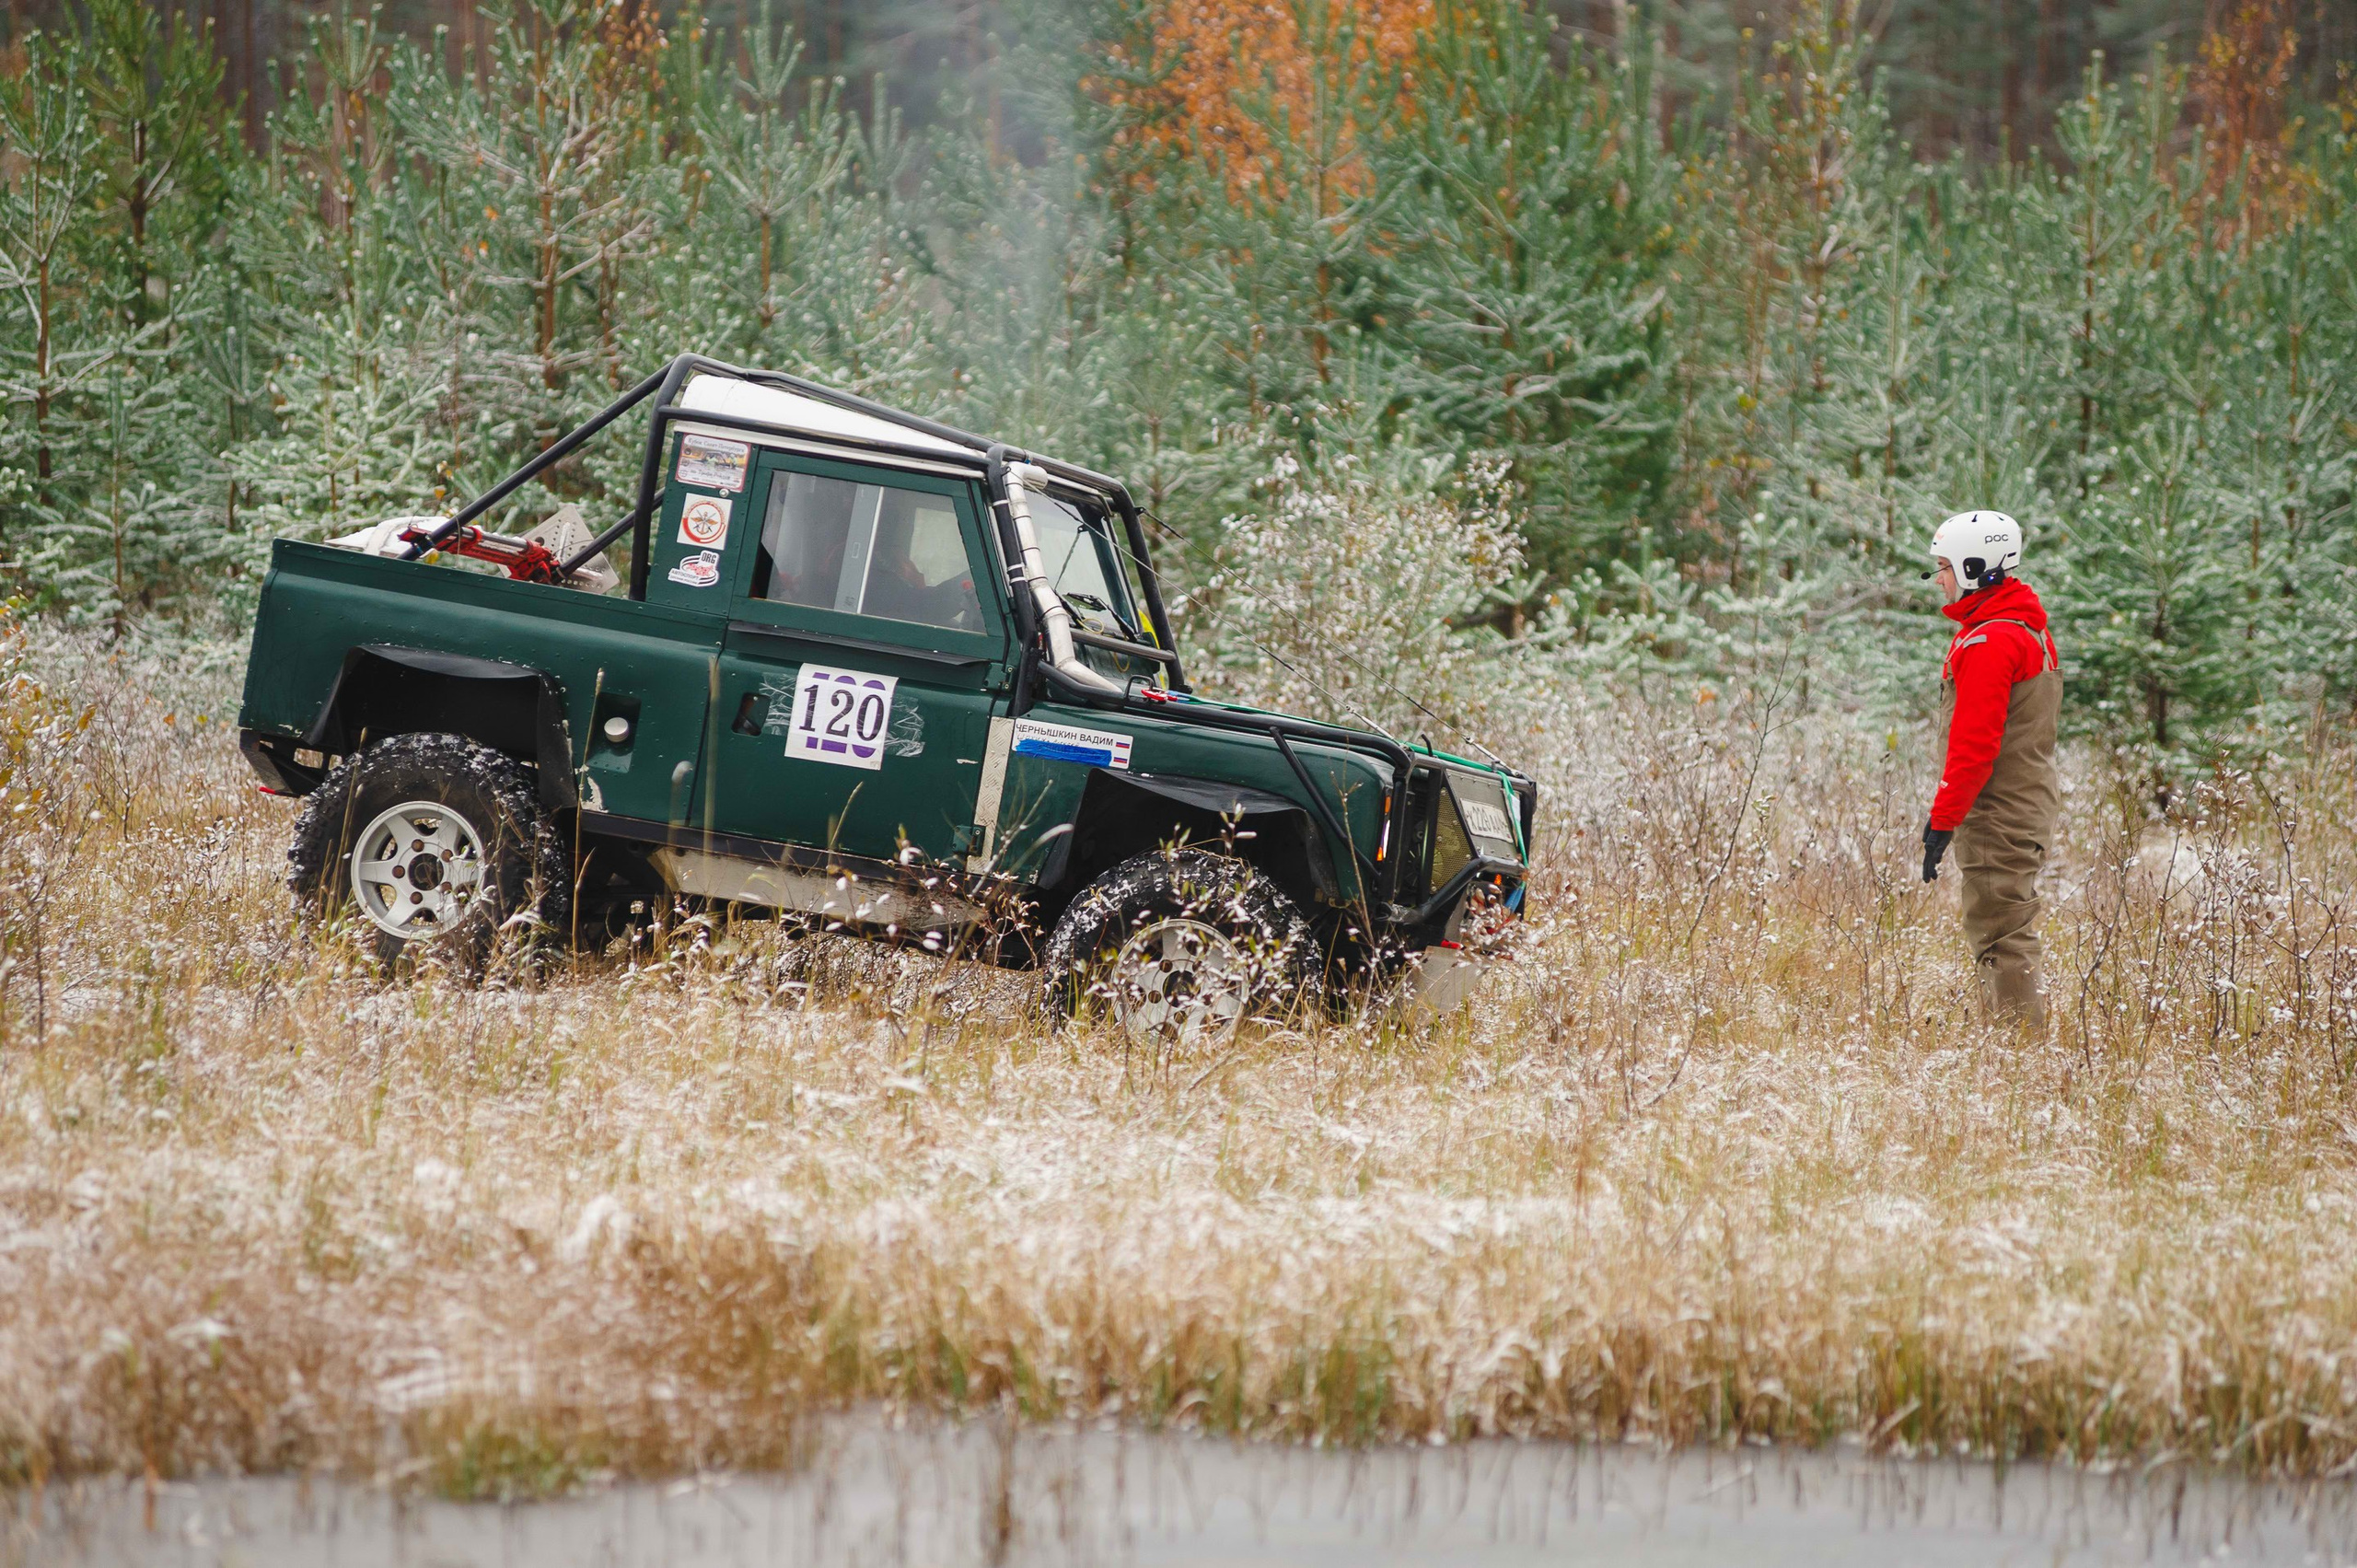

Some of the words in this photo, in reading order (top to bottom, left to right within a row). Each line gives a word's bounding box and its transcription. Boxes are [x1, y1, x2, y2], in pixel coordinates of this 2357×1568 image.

[701, 552, 717, 564] ORG
[798, 684, 885, 742] 120
[1016, 724, 1077, 740] ЧЕРНЫШКИН
[1079, 733, 1114, 747] ВАДИМ
